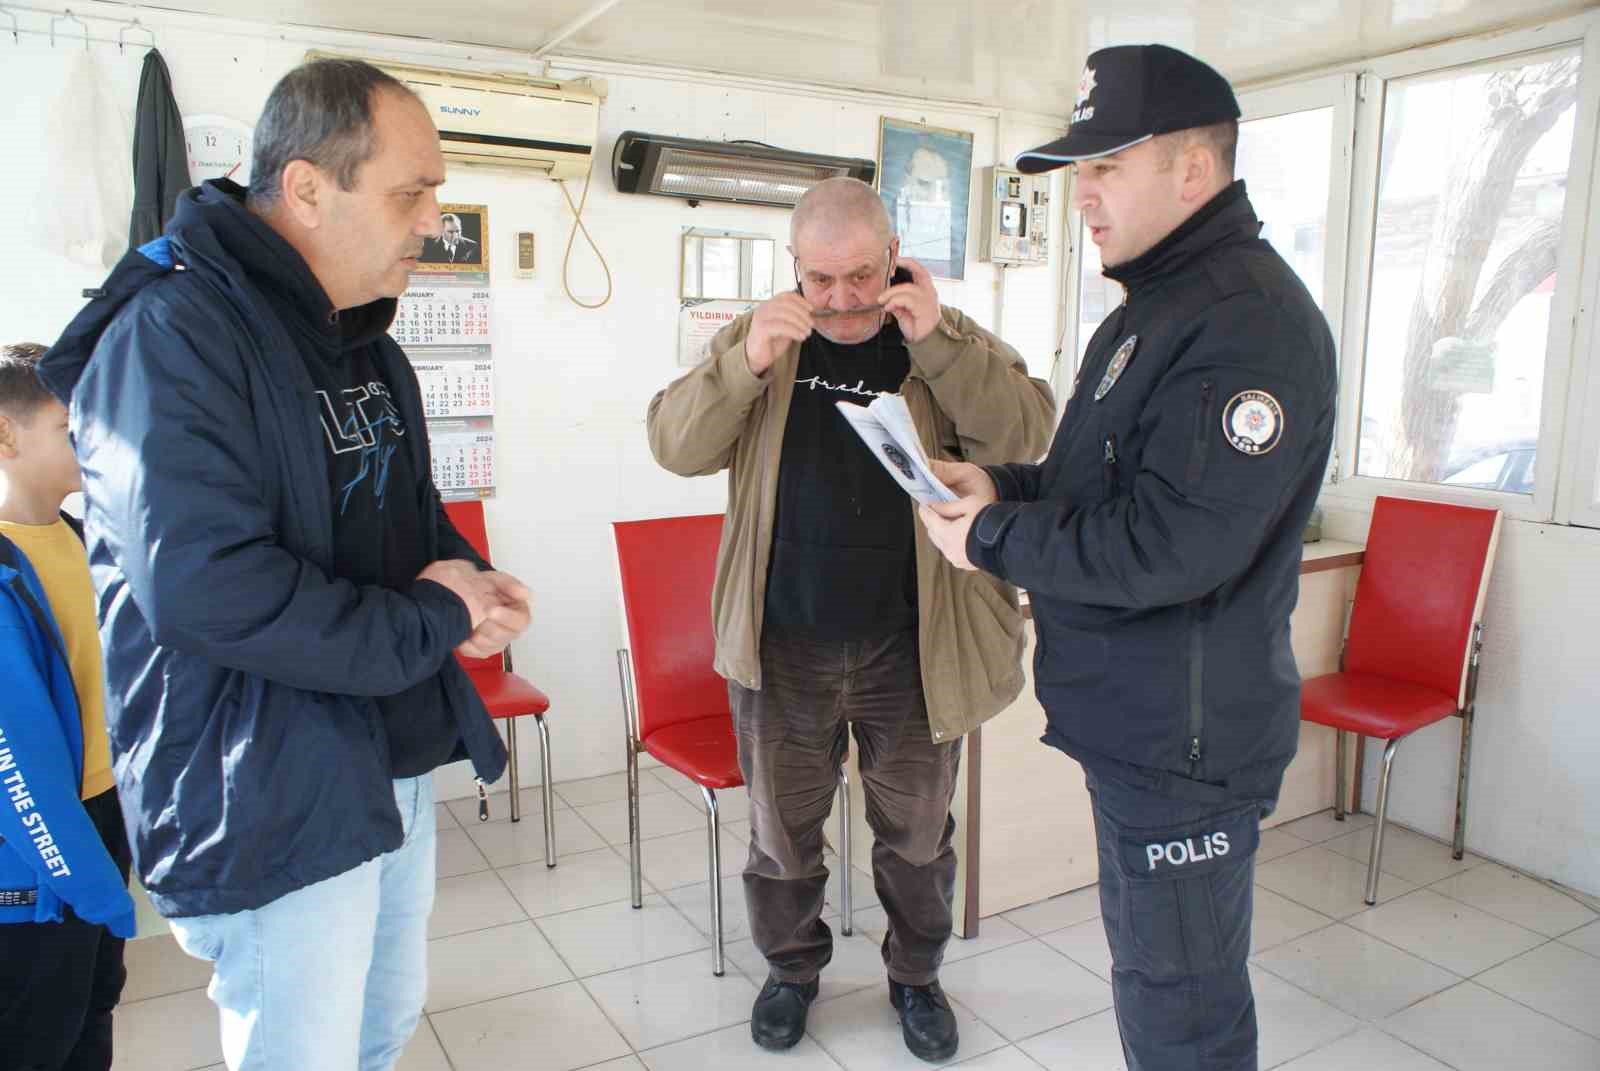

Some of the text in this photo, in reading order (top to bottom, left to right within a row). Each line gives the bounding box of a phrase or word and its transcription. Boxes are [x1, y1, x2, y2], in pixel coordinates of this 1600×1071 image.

[440, 105, 480, 117] SUNNY
[206, 135, 217, 147] 12
[690, 311, 733, 321] YILDIRIM
[4, 770, 35, 813] THE
[22, 812, 71, 877] STREET
